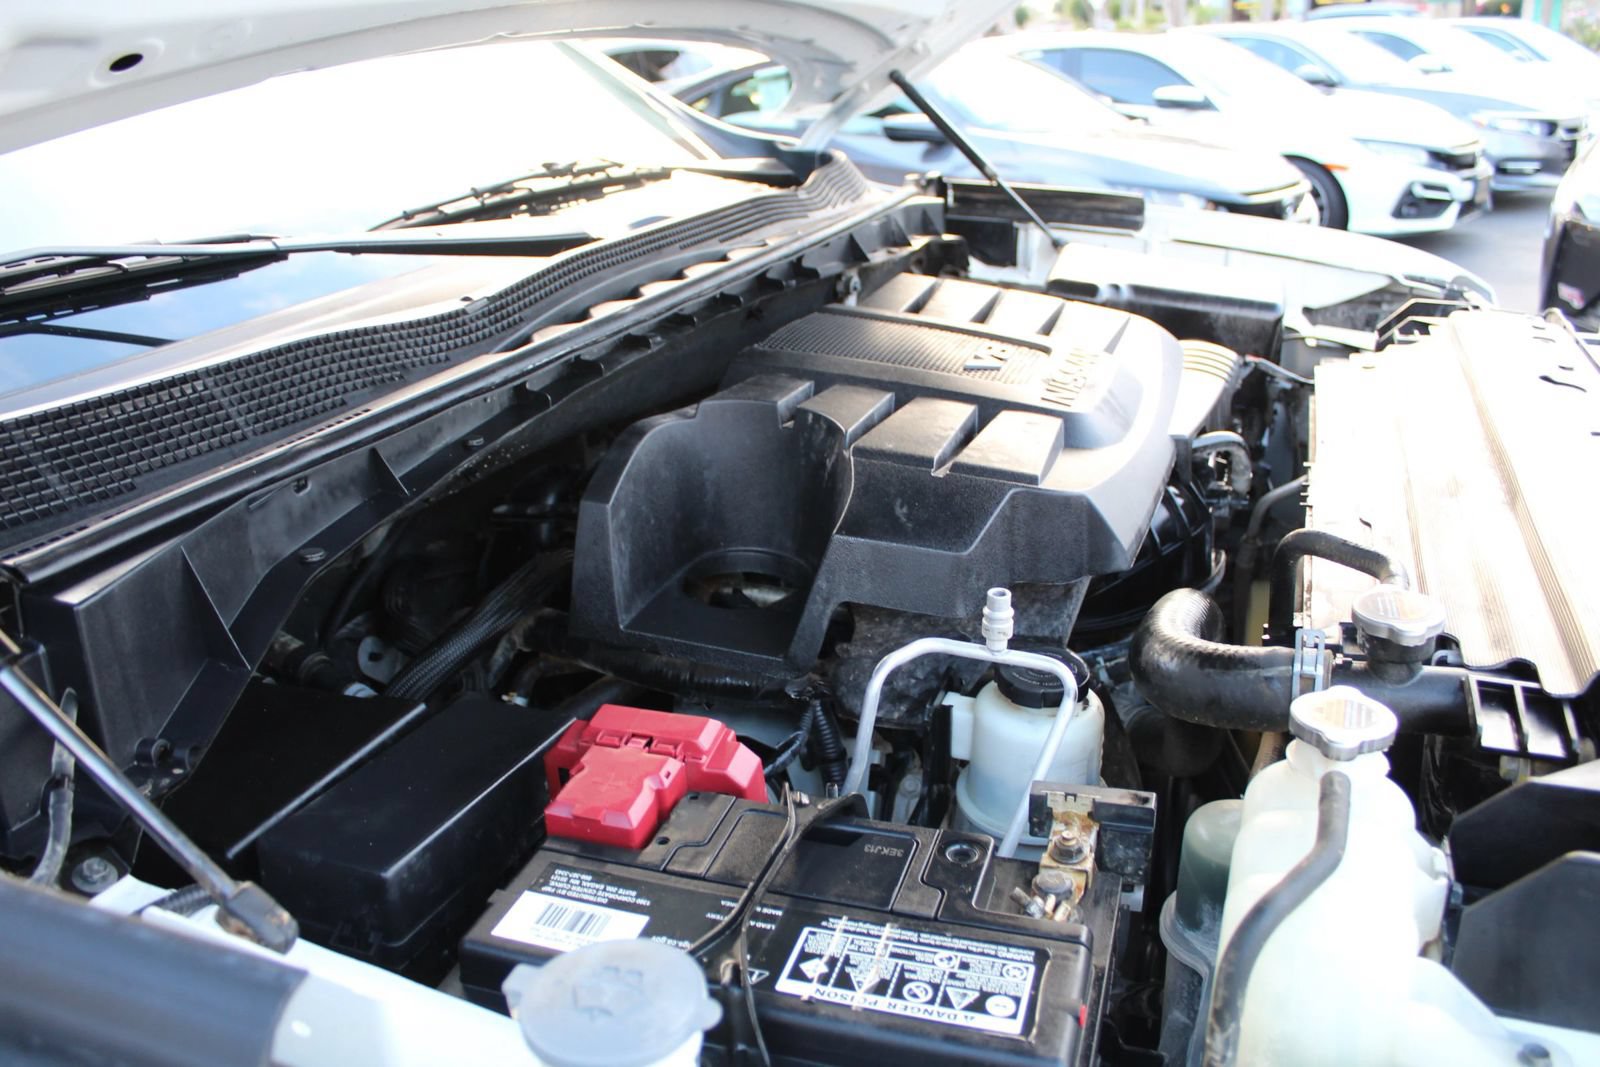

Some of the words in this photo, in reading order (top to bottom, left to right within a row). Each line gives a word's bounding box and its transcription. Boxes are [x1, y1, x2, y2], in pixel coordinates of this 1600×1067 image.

[762, 907, 783, 916] MADE
[756, 921, 775, 930] LEAD
[886, 1000, 958, 1022] DANGER
